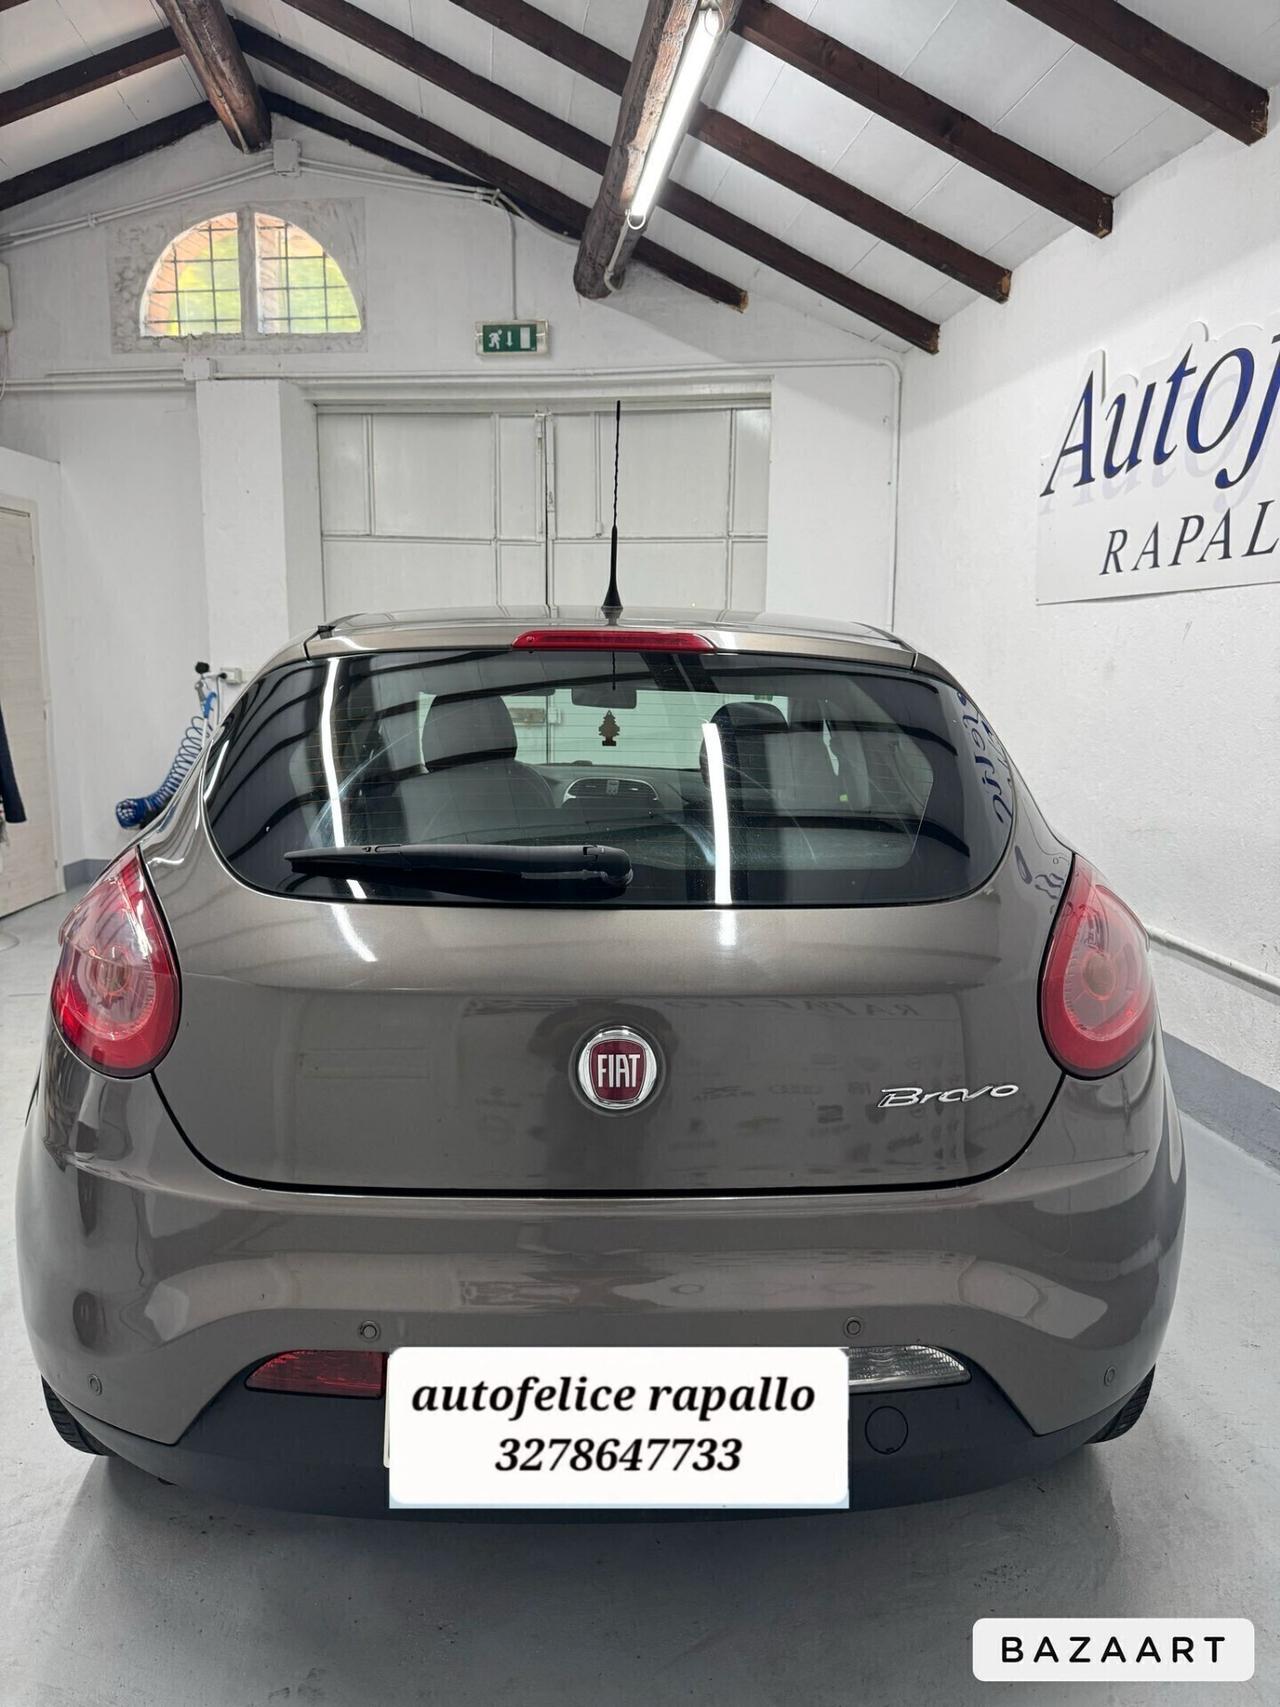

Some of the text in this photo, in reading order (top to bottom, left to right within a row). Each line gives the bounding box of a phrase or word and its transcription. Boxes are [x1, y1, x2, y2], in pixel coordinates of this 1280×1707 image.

[1099, 500, 1280, 575] RAPAL
[597, 1054, 641, 1088] FIAT
[877, 1084, 1020, 1108] Bravo
